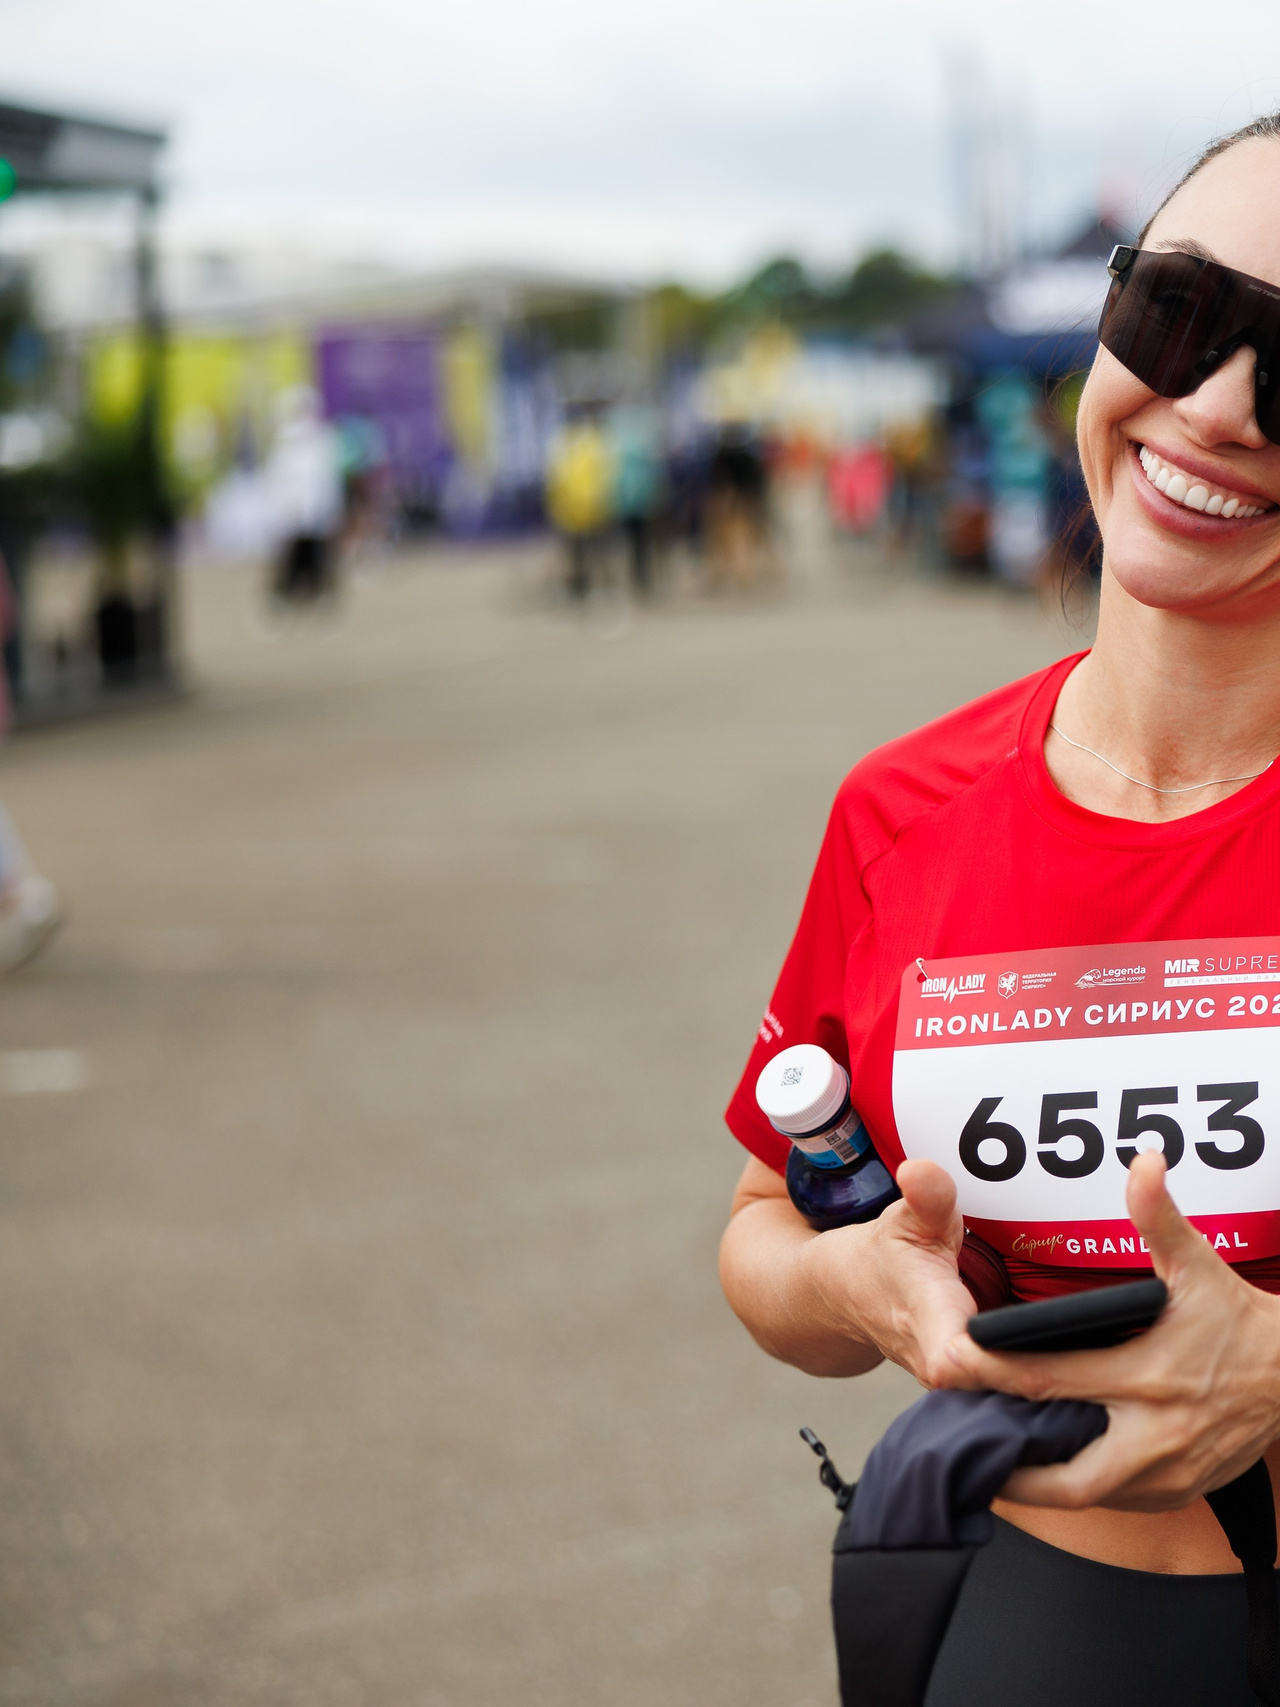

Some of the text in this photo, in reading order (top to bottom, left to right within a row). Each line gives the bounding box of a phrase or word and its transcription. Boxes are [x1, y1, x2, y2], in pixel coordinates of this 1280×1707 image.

[1102, 965, 1146, 977] Legenda
[1164, 958, 1200, 974] MIR
[1021, 971, 1057, 980] ФЕДЕРАЛЬНАЯ
[1021, 977, 1052, 985] ТЕРРИТОРИЯ
[1170, 975, 1249, 985] ГЕНЕРАЛЬНЫЙ
[921, 974, 986, 993] IRON LADY
[915, 1006, 1073, 1038] IRONLADY
[1084, 997, 1216, 1026] СИРИУС
[958, 1080, 1266, 1182] 6553
